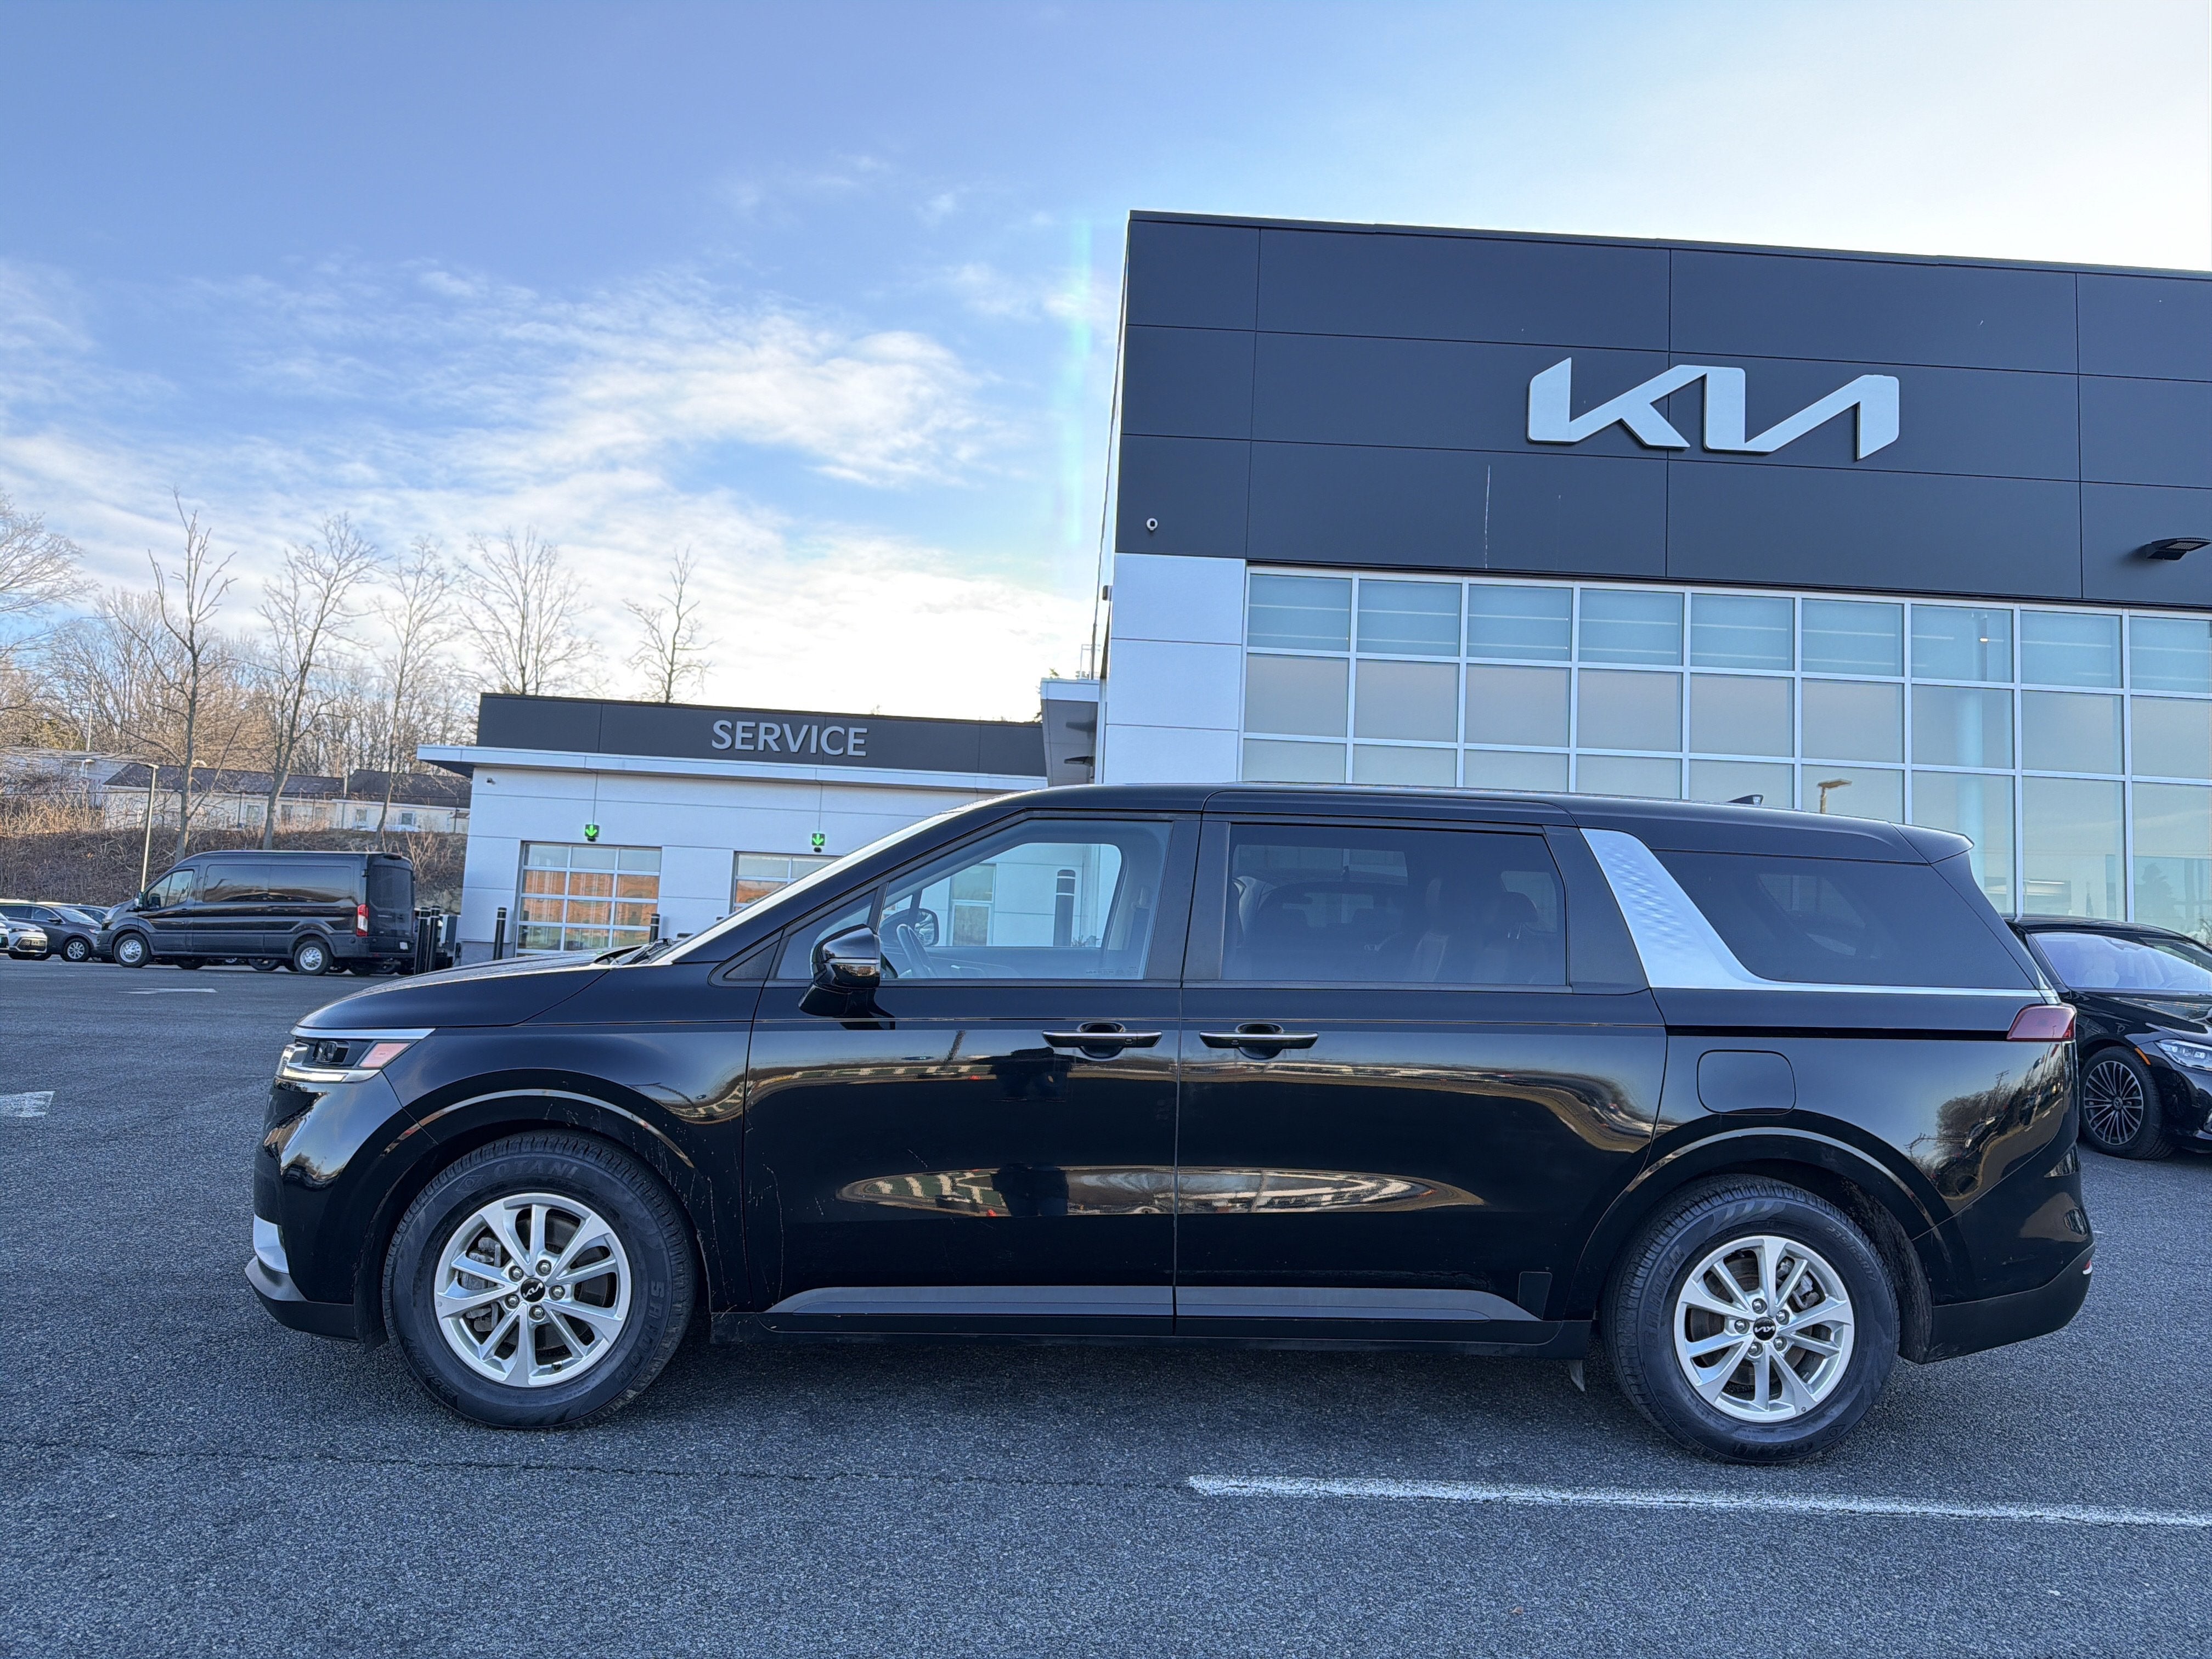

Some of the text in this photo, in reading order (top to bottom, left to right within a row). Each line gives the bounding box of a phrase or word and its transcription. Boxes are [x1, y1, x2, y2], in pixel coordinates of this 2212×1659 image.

[712, 720, 867, 756] SERVICE
[494, 1160, 578, 1178] OTANI
[1825, 1225, 1877, 1282] 235/65R17
